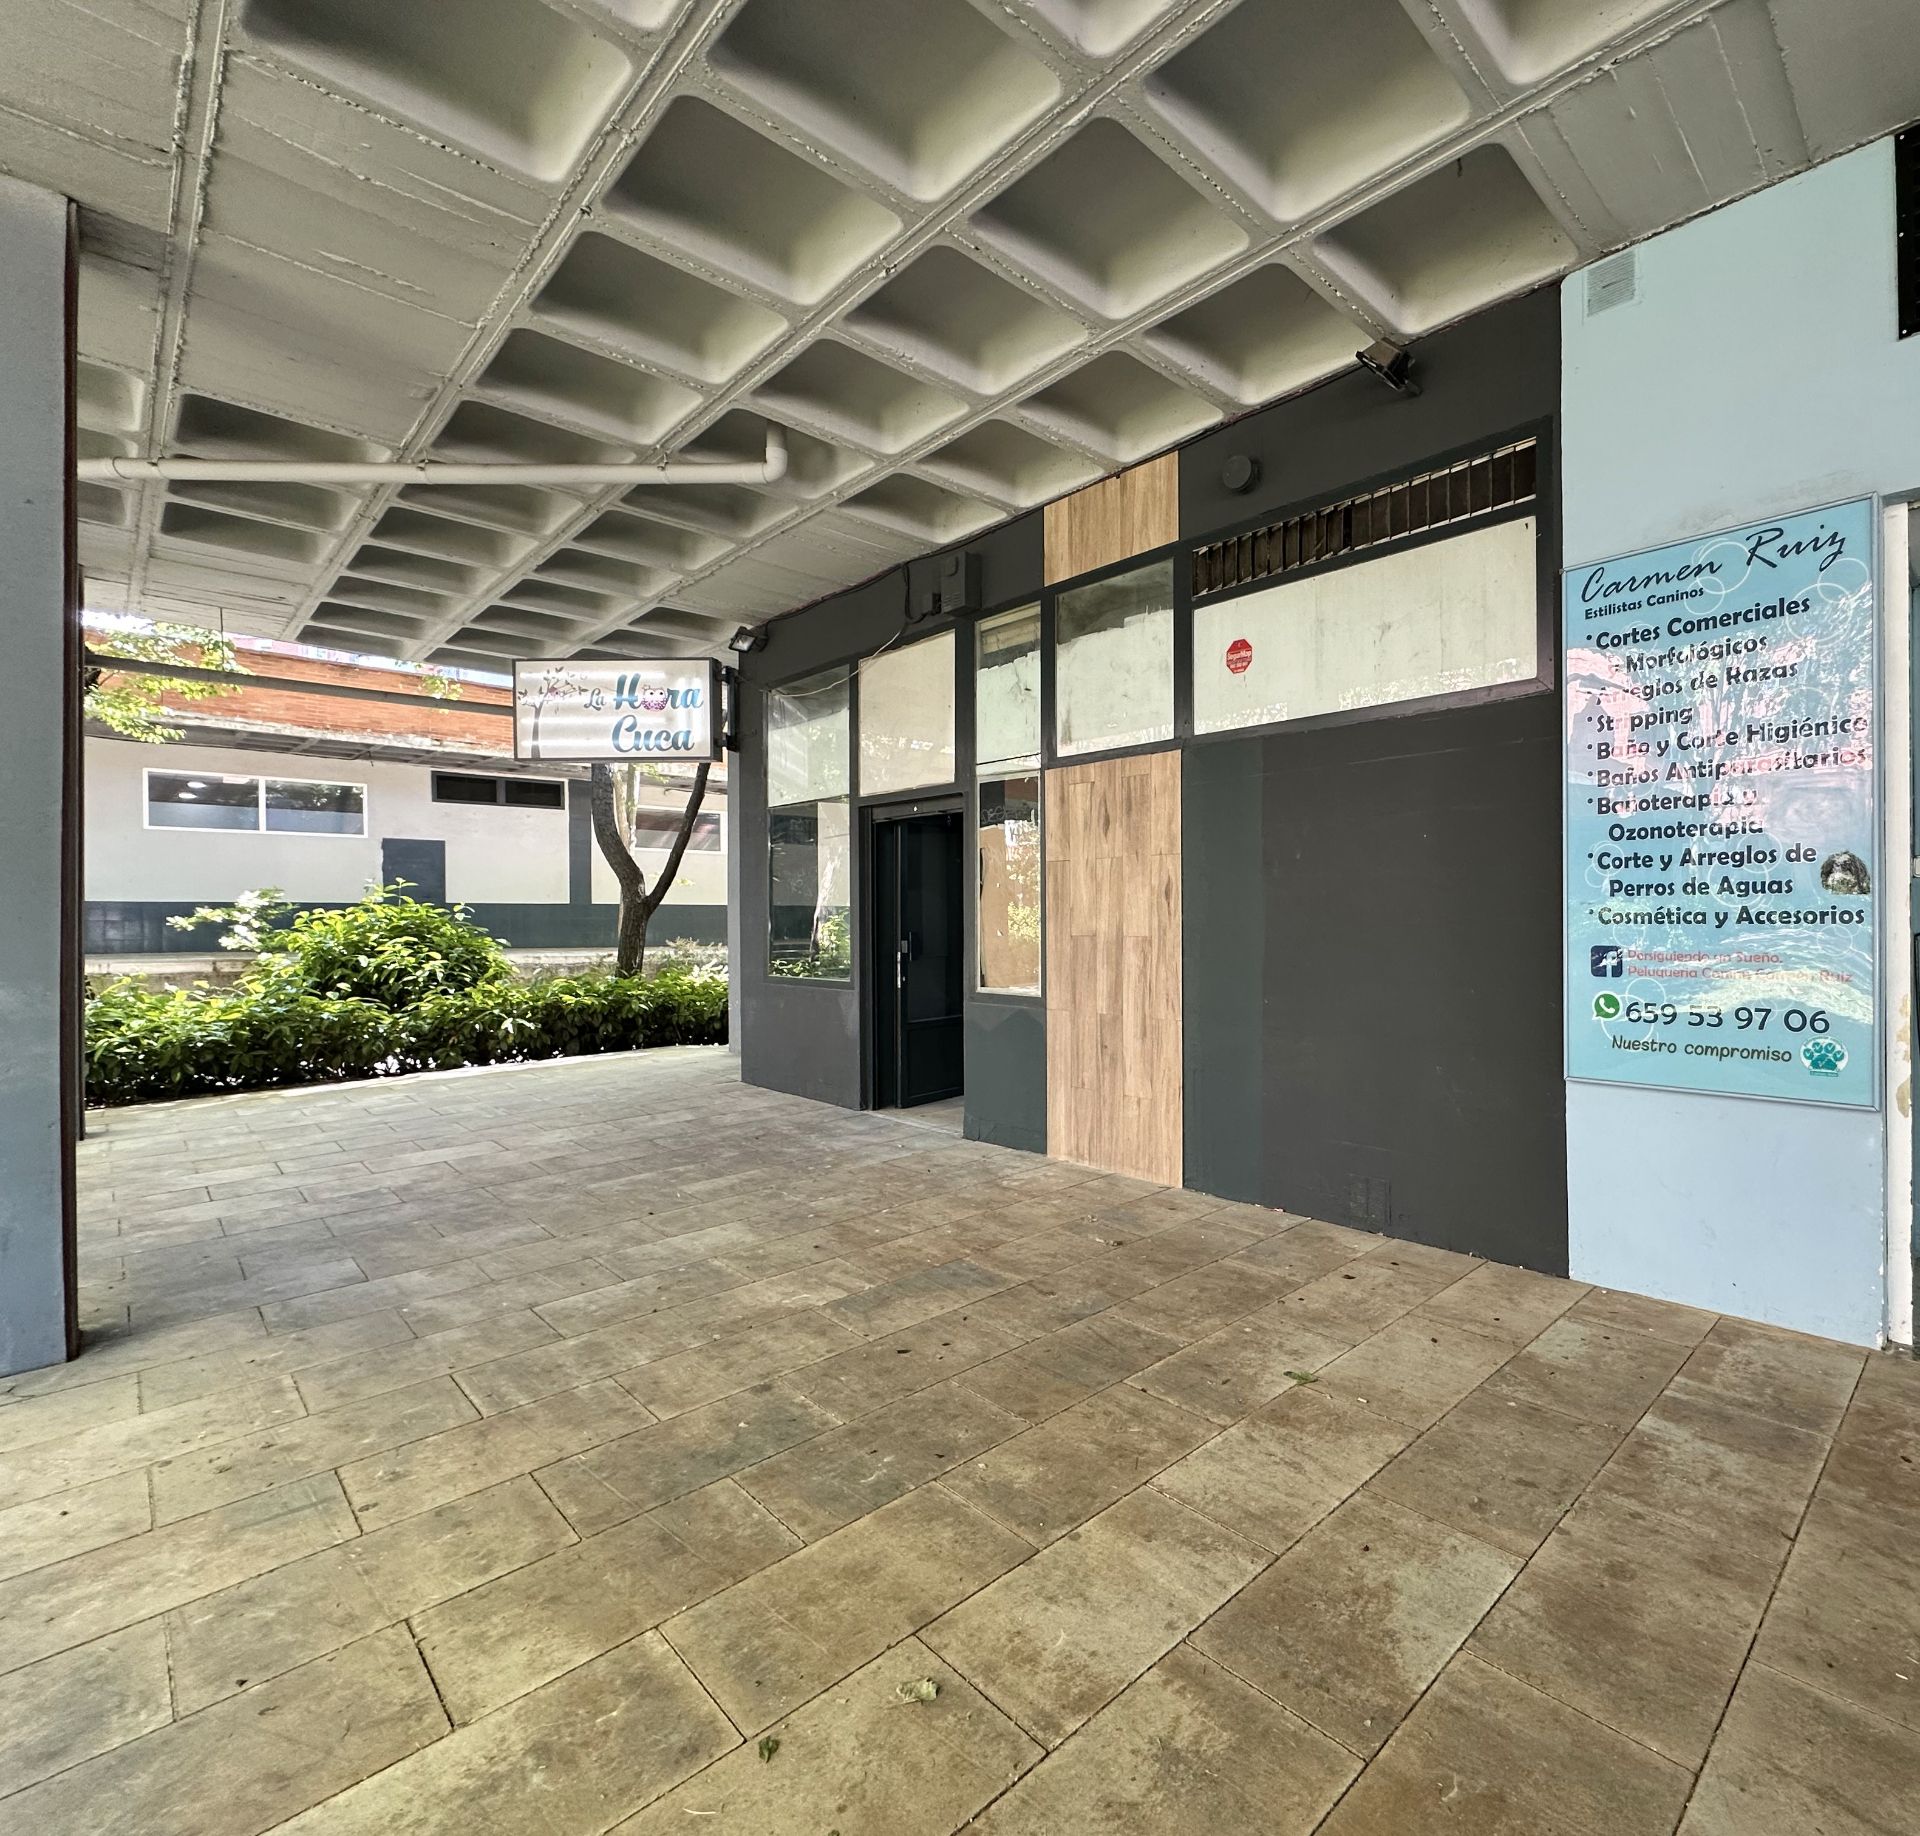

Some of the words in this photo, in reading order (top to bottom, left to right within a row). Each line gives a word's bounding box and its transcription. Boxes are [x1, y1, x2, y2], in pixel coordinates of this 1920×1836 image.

[1581, 566, 1722, 603] Carmen
[1746, 524, 1846, 571] Ruiz
[1584, 599, 1643, 620] Estilistas
[1647, 587, 1704, 608] Caninos
[1596, 623, 1660, 650] Cortes
[1667, 596, 1811, 637] Comerciales
[1626, 635, 1768, 673] Morfológicos
[584, 688, 606, 711] La
[1596, 676, 1683, 706] Aeglos
[1691, 670, 1719, 690] de
[1726, 661, 1799, 686] Razas
[612, 714, 695, 753] Cuca
[1597, 737, 1650, 760] Baño
[1657, 740, 1670, 757] y
[1677, 730, 1739, 751] Corte
[1747, 714, 1868, 745] Higiénico
[1597, 766, 1659, 788] Baños
[1666, 747, 1867, 781] Antiparasitarios
[1608, 817, 1764, 842] Ozonoterapia
[1597, 852, 1654, 870] Corte
[1660, 854, 1673, 871] y
[1679, 846, 1777, 868] Arreglos
[1786, 843, 1817, 863] de
[1609, 877, 1675, 898] Perros
[1682, 875, 1710, 896] de
[1717, 875, 1794, 898] Aguas
[1598, 902, 1707, 926] Cosmética
[1714, 910, 1729, 928] y
[1736, 904, 1865, 926] Accesorios
[1625, 1002, 1678, 1026] 659
[1688, 1003, 1723, 1028] 53
[1735, 1006, 1772, 1031] 97
[1783, 1008, 1830, 1034] 06
[1612, 1035, 1678, 1055] Nuestro
[1684, 1042, 1792, 1062] compromiso
